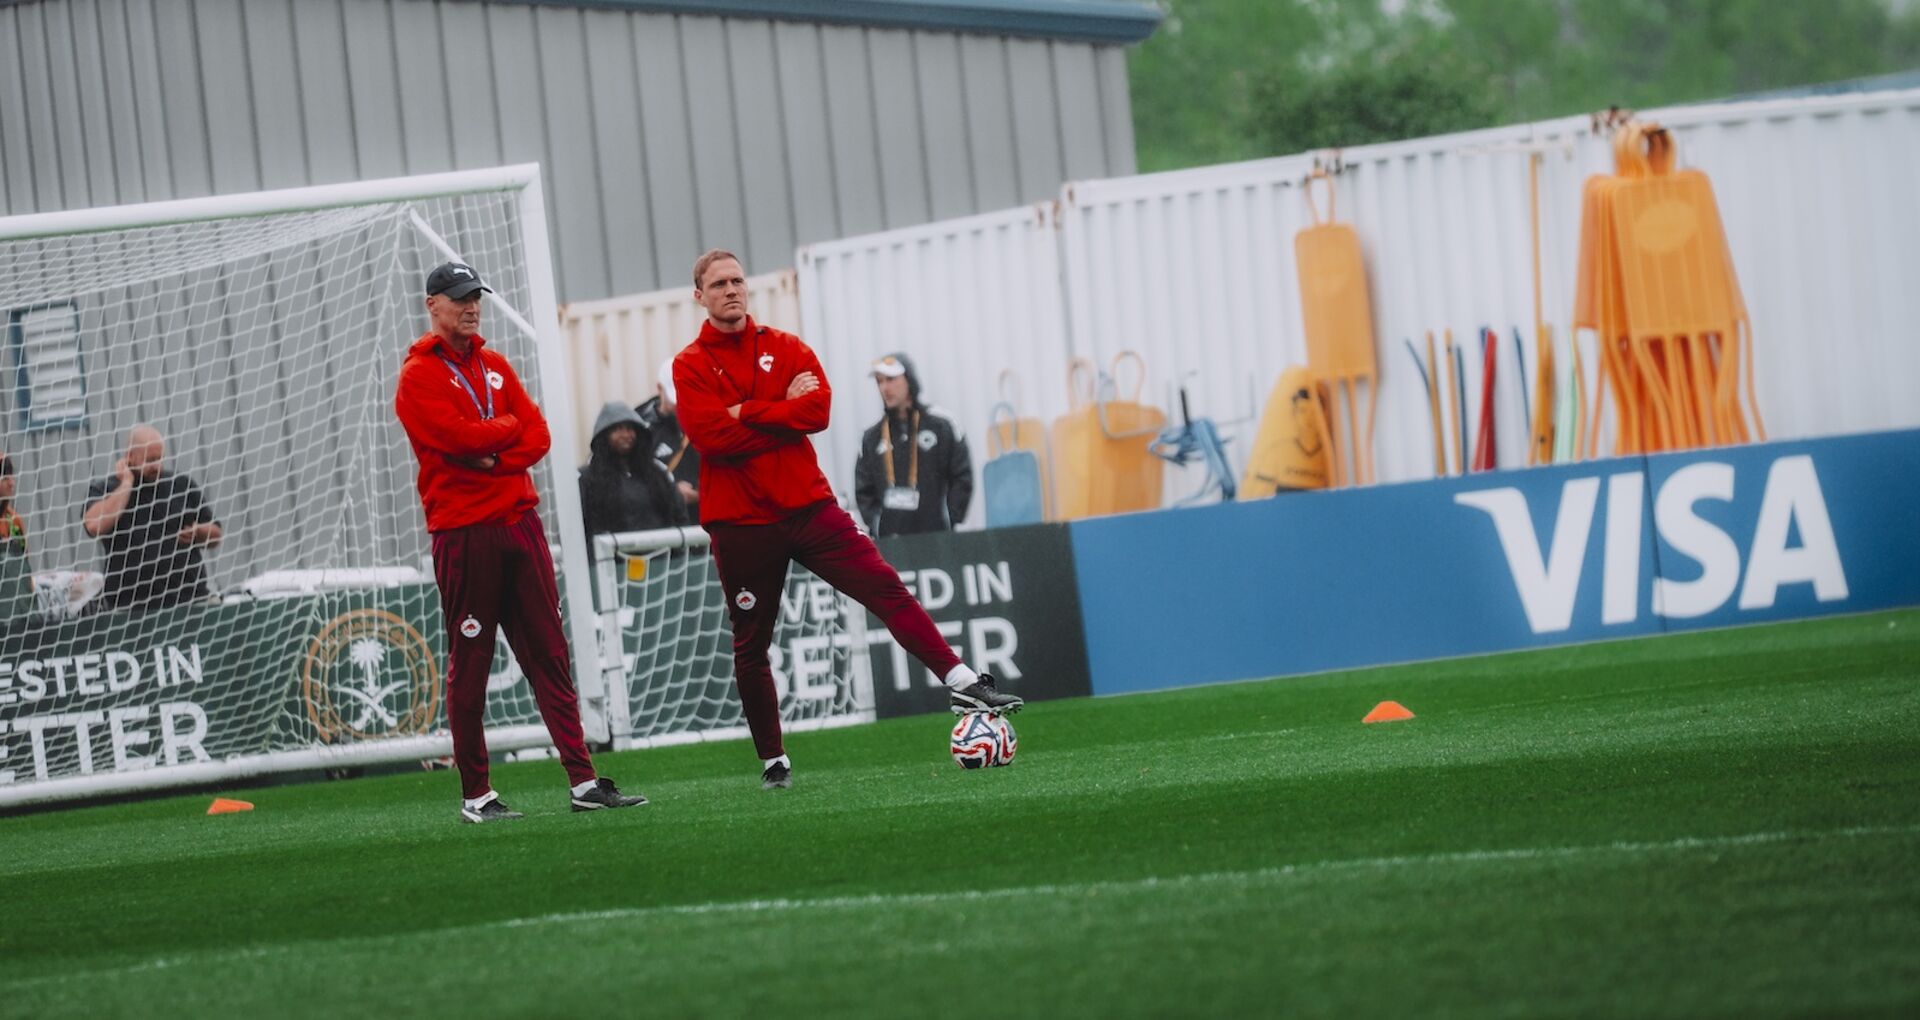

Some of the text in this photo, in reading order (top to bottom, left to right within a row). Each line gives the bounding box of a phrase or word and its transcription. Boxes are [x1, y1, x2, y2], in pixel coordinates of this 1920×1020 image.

[1454, 454, 1849, 634] VISA
[962, 561, 1013, 605] IN
[154, 643, 203, 687] IN
